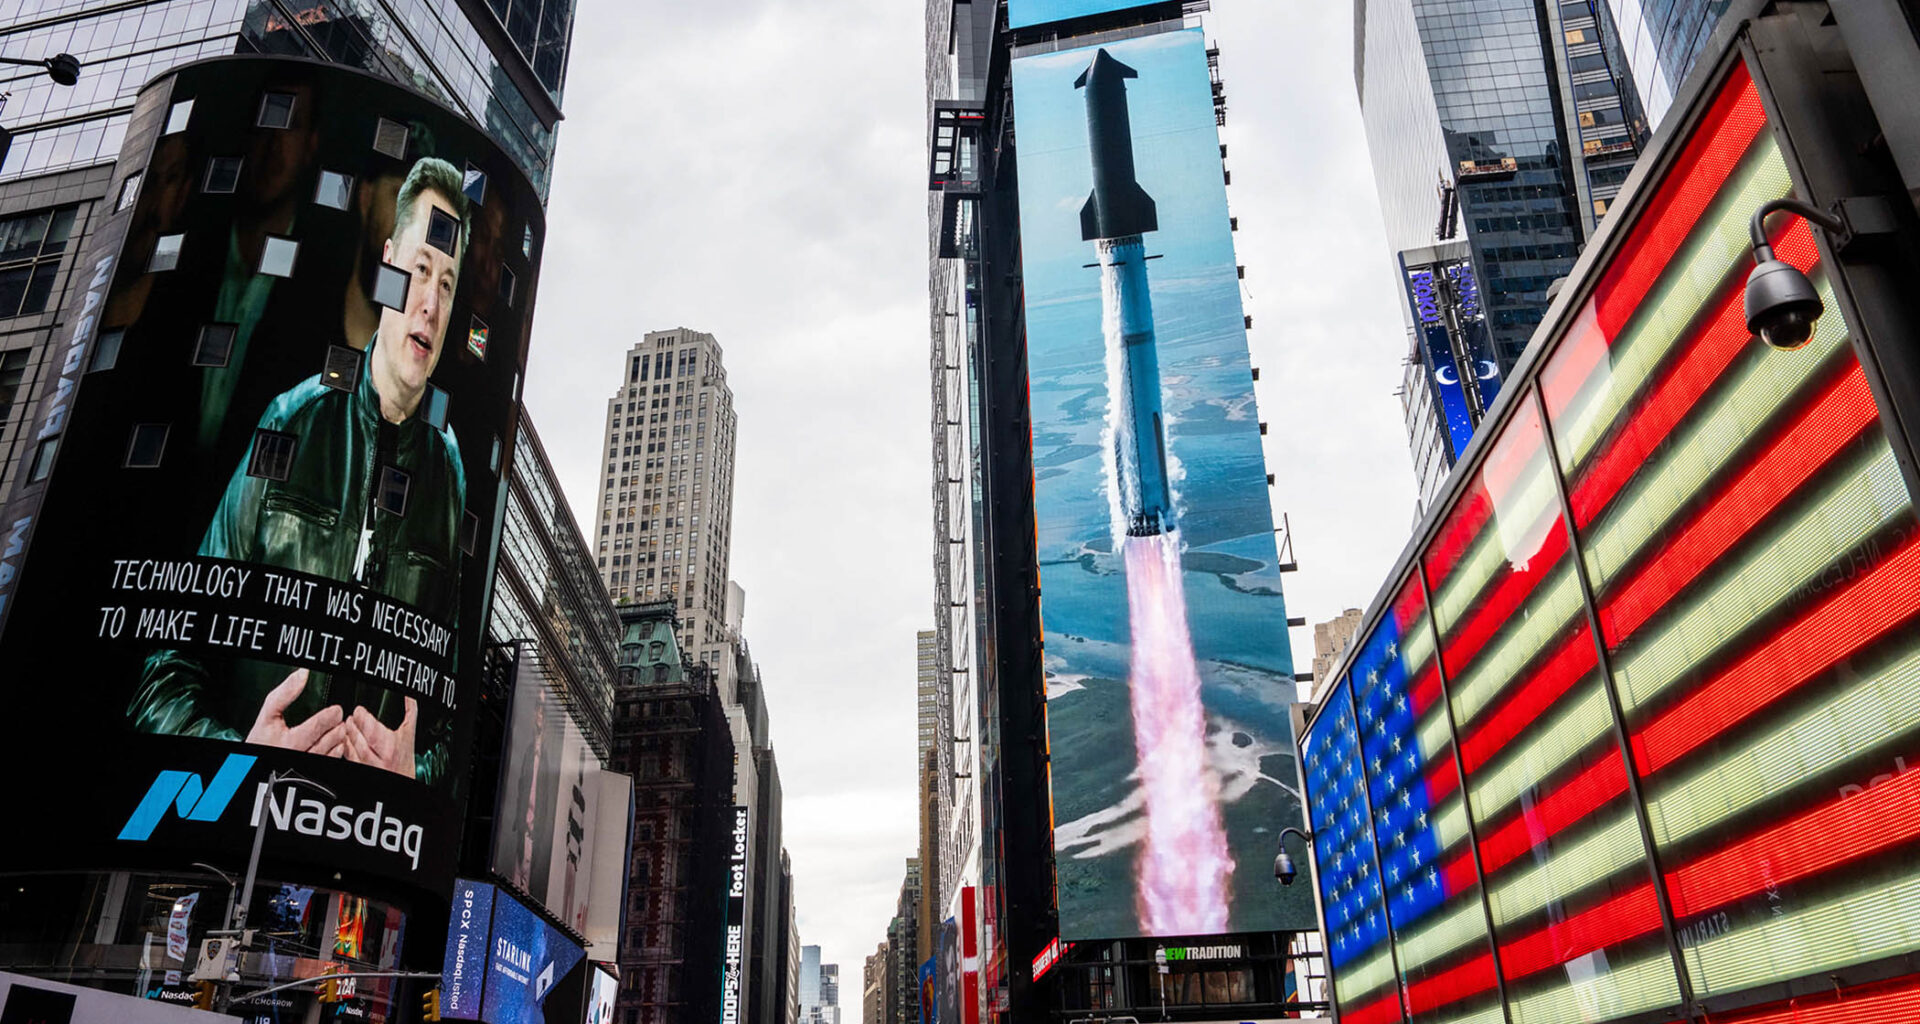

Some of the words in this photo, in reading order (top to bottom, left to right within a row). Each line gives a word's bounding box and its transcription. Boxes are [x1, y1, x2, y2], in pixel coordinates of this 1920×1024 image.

[37, 254, 114, 441] NASDAQ
[0, 516, 32, 616] MA
[111, 559, 250, 598] TECHNOLOGY
[264, 573, 318, 611] THAT
[326, 586, 363, 624] WAS
[372, 600, 451, 658] NECESSARY
[98, 606, 126, 638] TO
[135, 607, 197, 641] MAKE
[209, 616, 267, 650] LIFE
[278, 624, 438, 697] MULTI-PLANETARY
[443, 676, 457, 710] TO.
[250, 782, 424, 871] Nasdaq
[461, 890, 474, 928] SPCX
[729, 864, 744, 897] Foot
[497, 937, 532, 973] STARLINK
[726, 925, 741, 964] HERE
